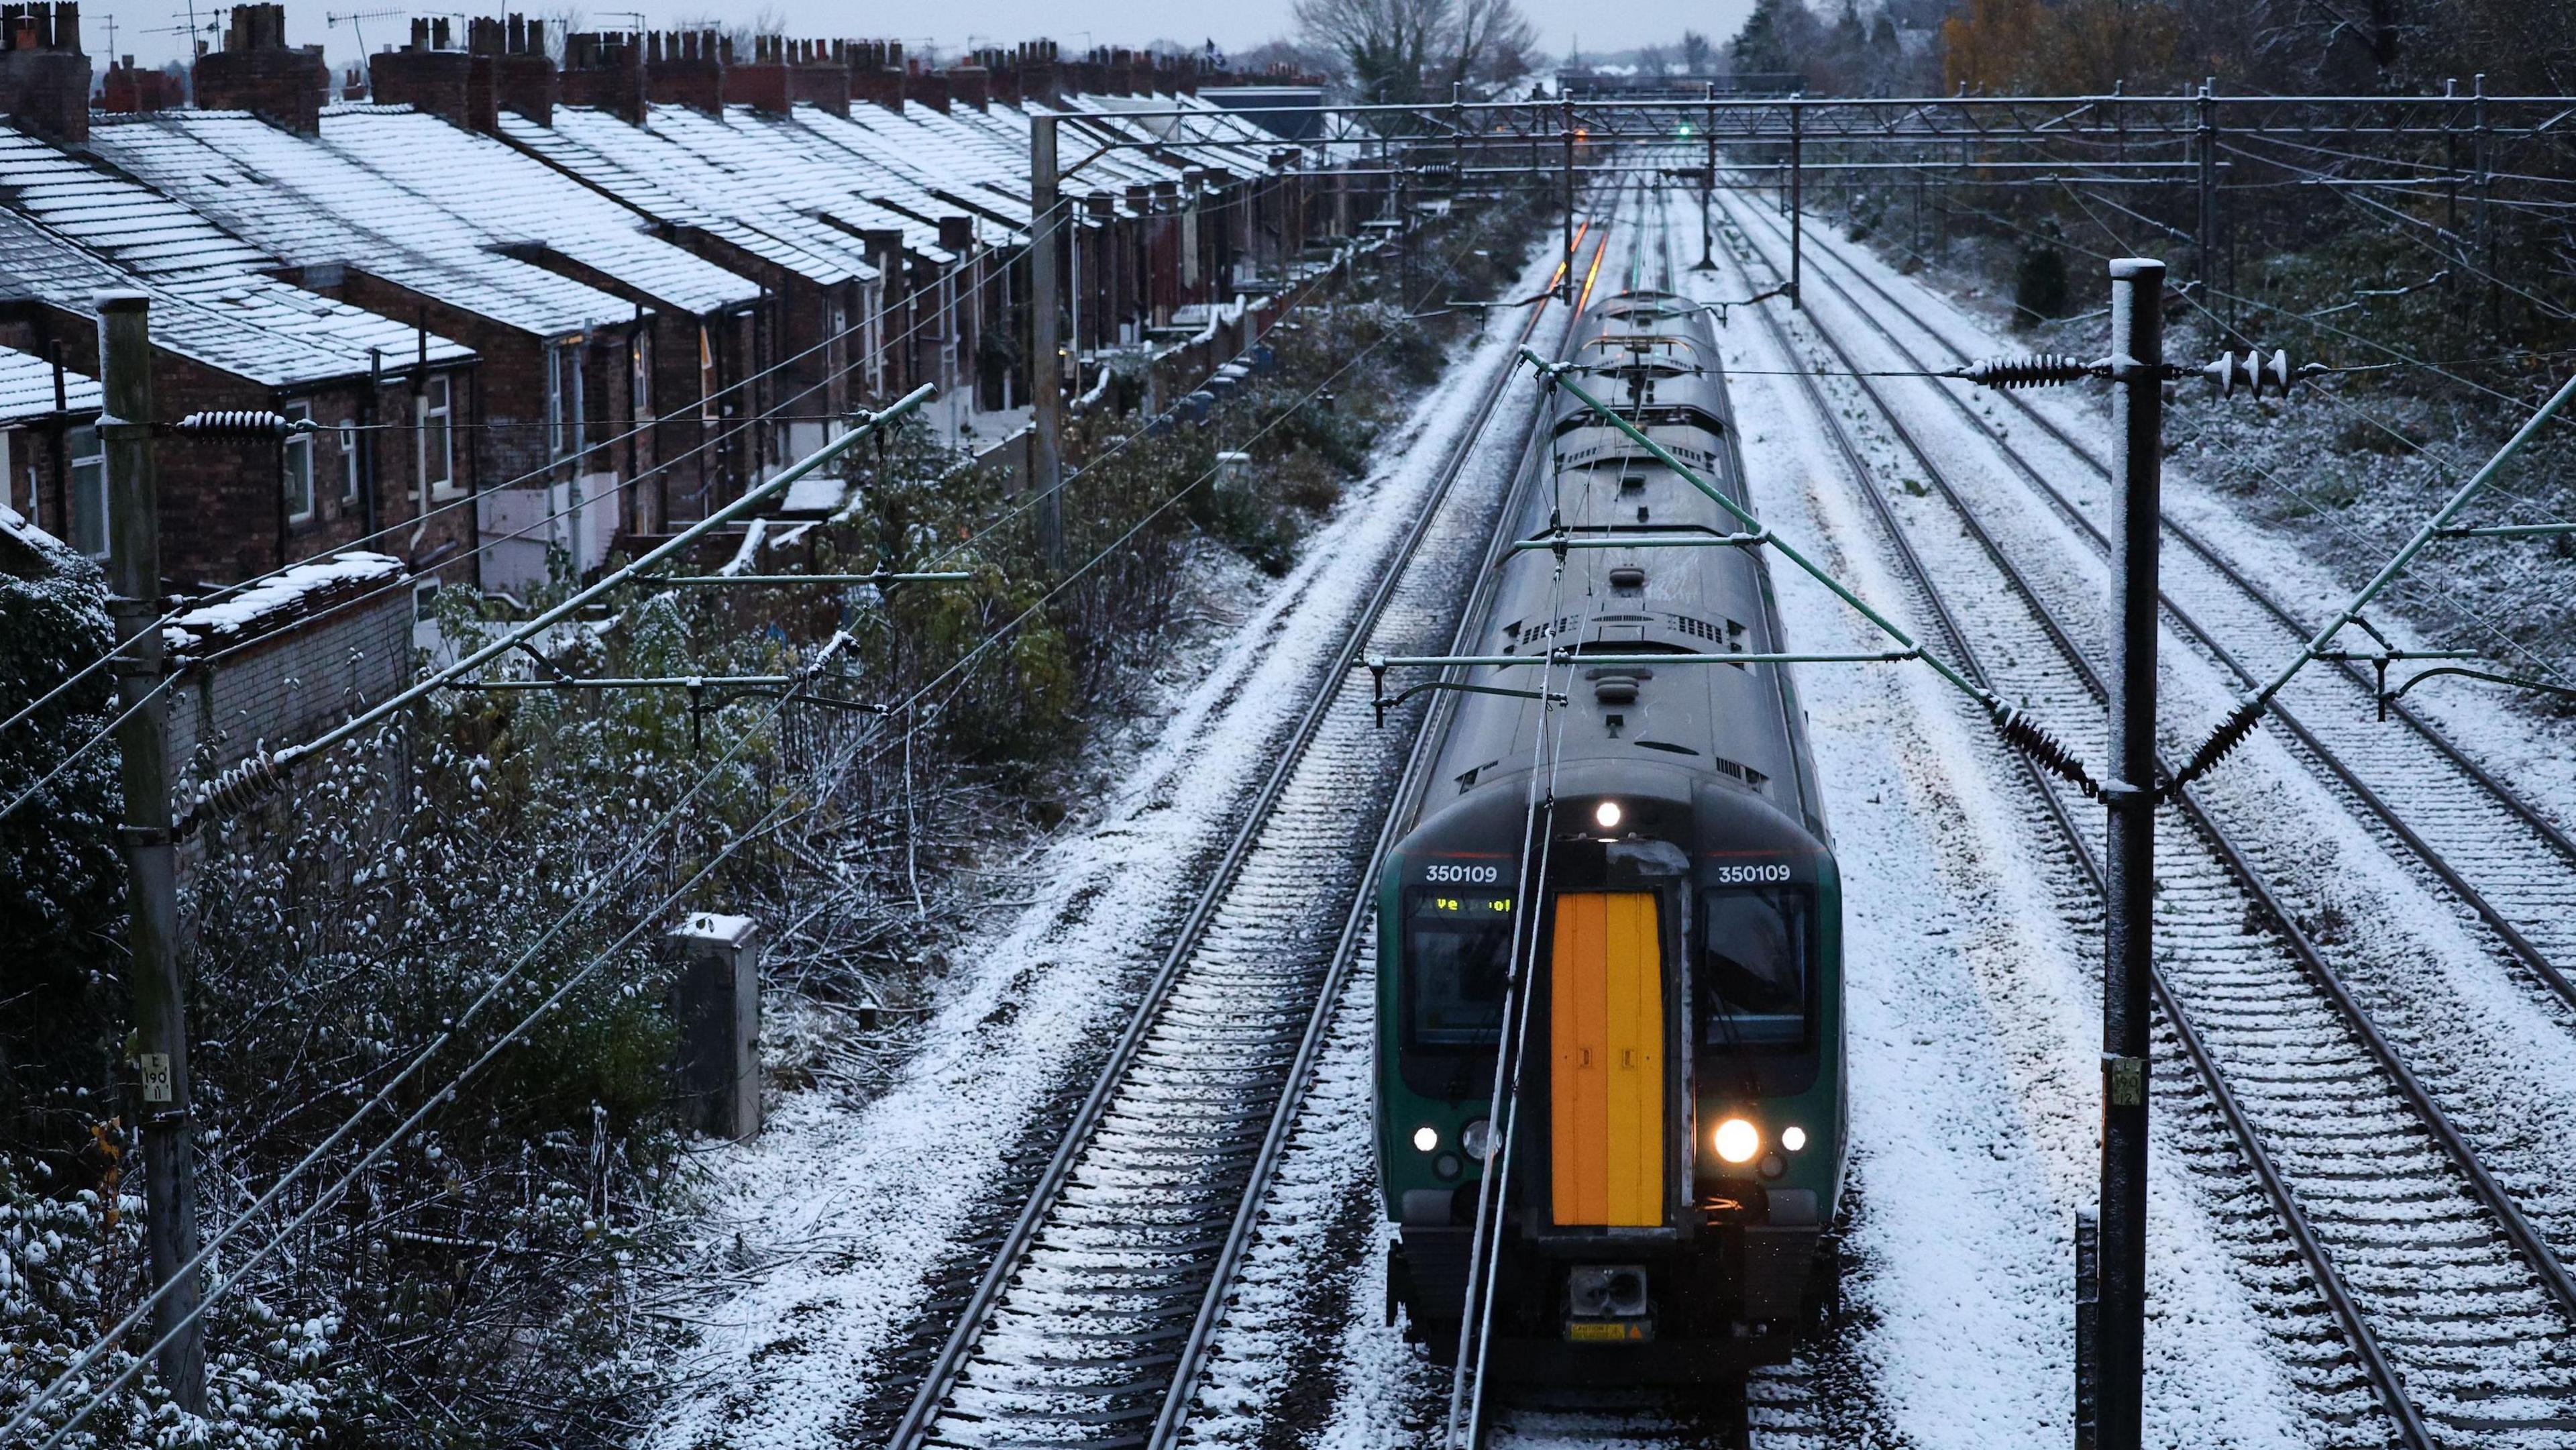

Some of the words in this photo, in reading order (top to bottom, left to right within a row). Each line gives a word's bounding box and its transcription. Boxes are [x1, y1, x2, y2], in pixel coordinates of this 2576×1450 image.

[1426, 865, 1497, 883] 350109
[1718, 864, 1790, 883] 350109
[145, 1072, 166, 1084] 190
[2120, 1092, 2133, 1104] 12
